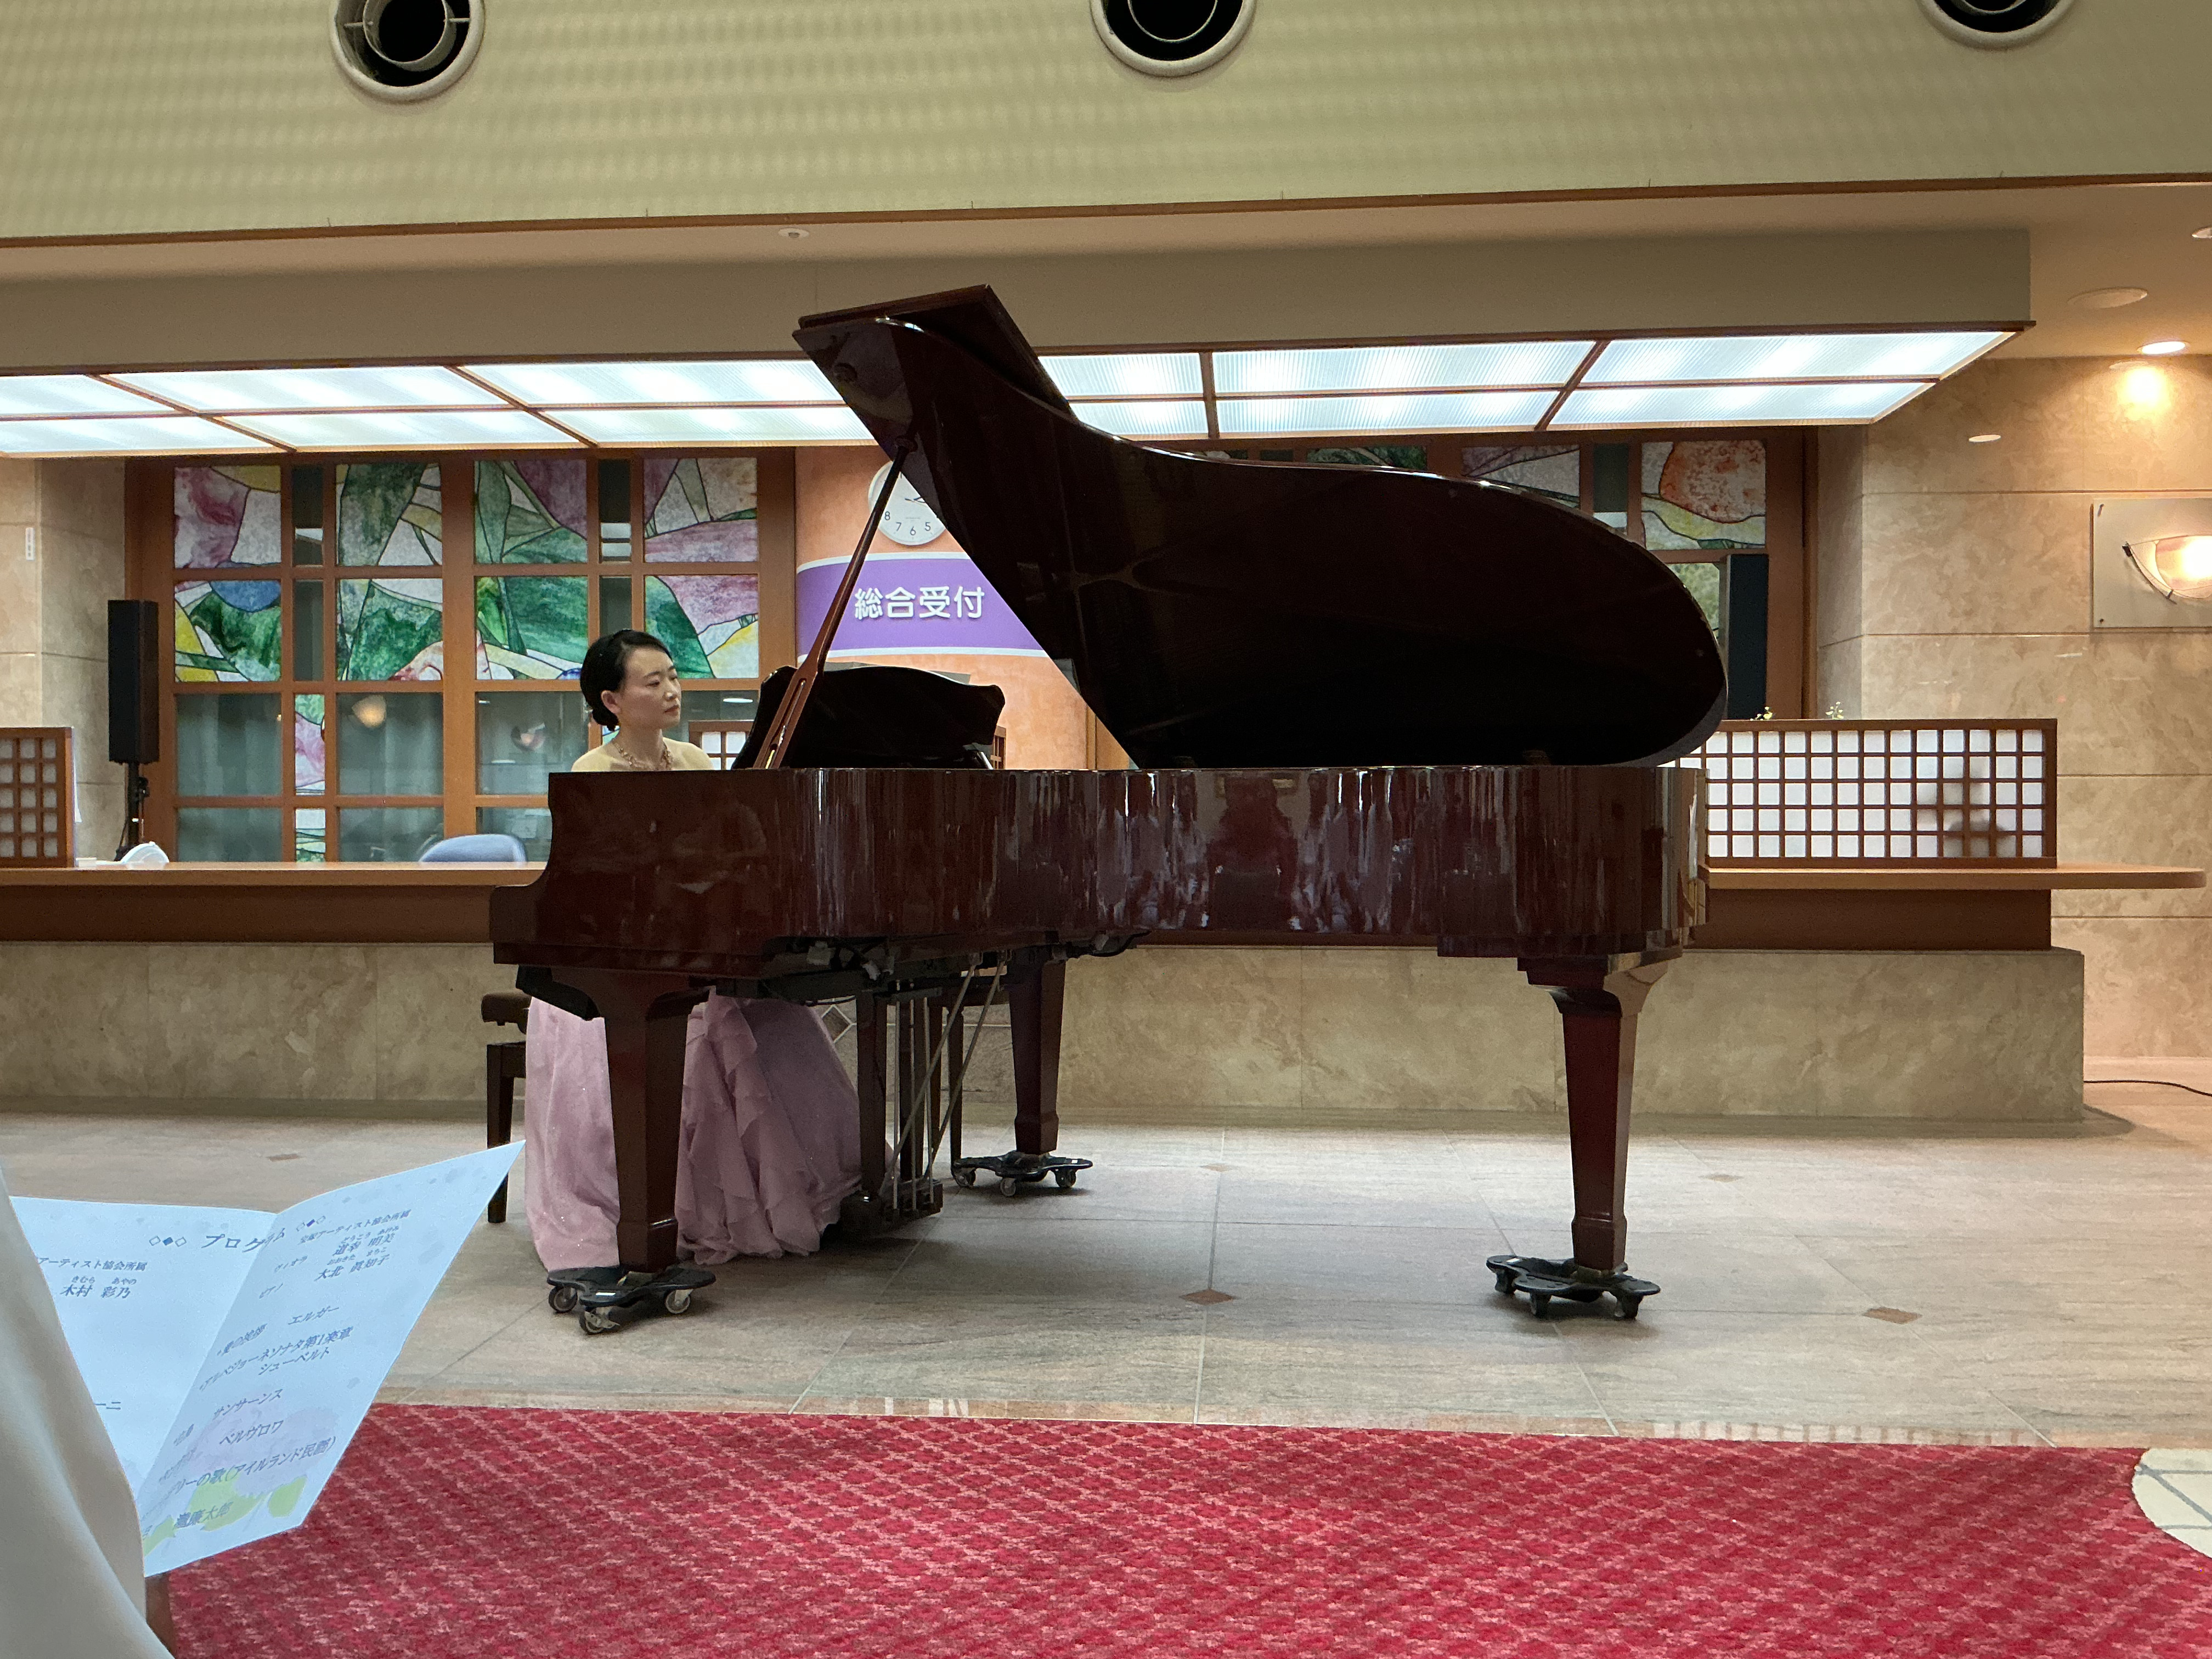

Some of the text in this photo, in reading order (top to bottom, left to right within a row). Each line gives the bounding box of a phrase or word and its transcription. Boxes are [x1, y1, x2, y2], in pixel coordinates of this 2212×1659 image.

[884, 511, 890, 521] 8
[895, 522, 902, 532] 7
[910, 526, 916, 535] 6
[924, 522, 931, 532] 5
[855, 586, 985, 620] 総合受付
[59, 1284, 93, 1297] 木村
[288, 1305, 340, 1325] エルガー
